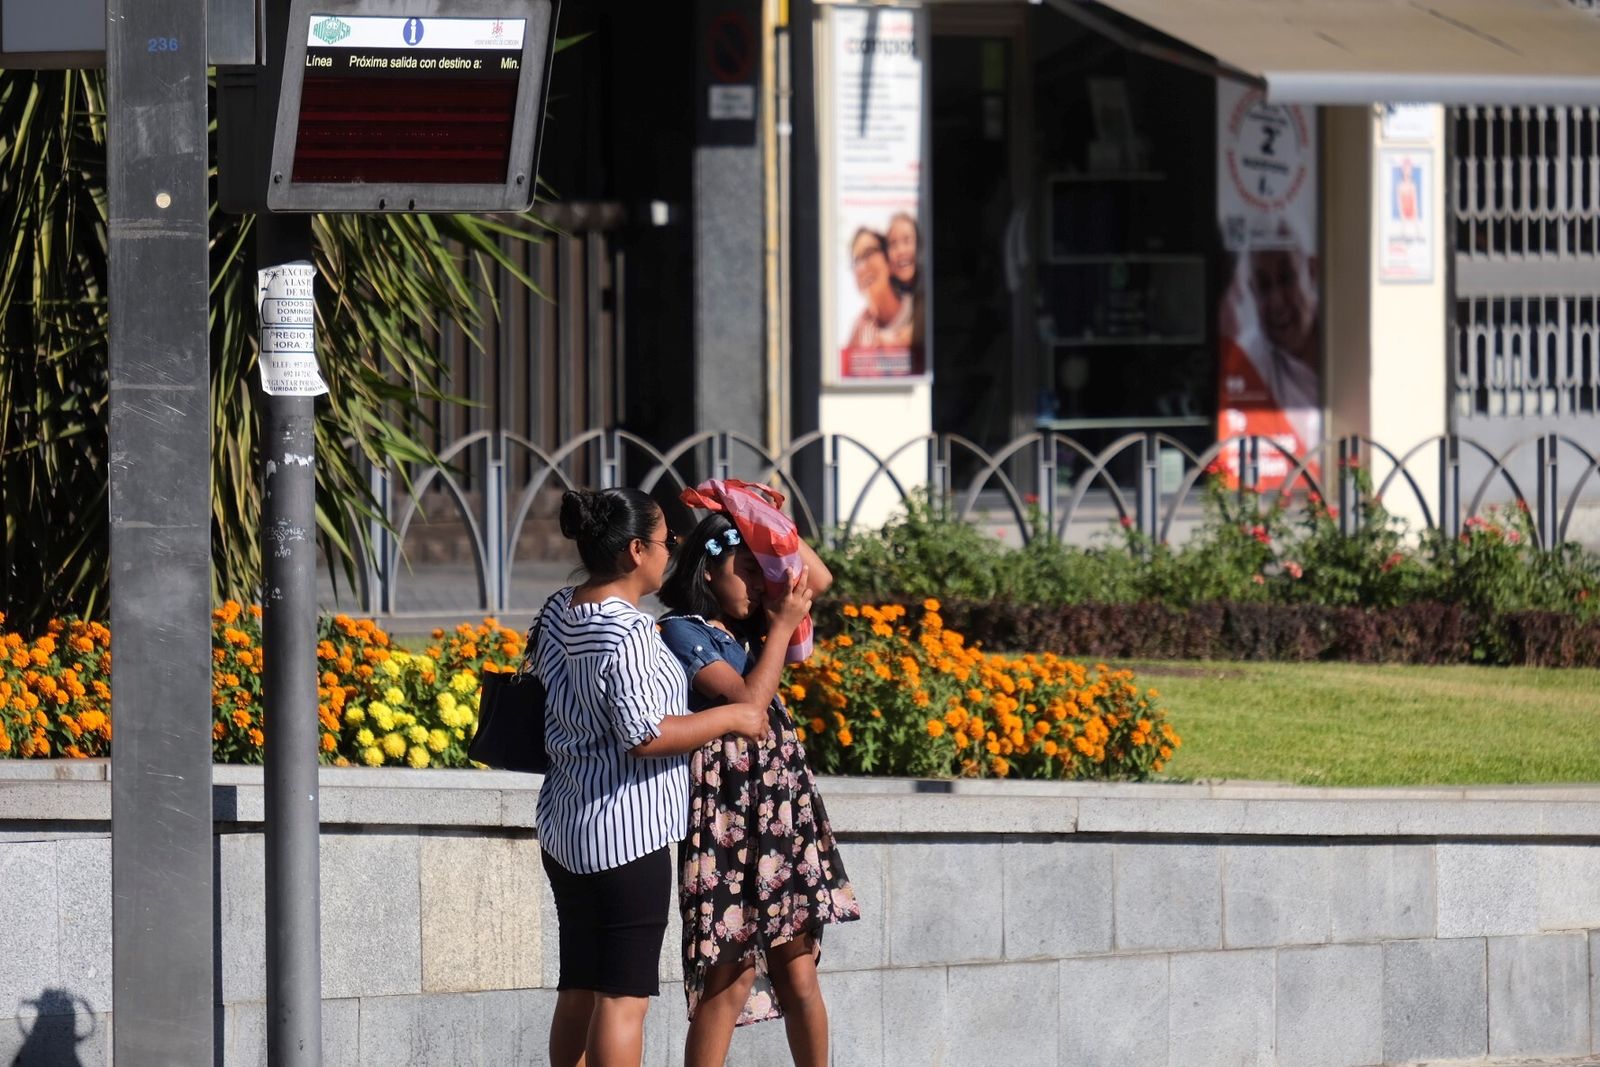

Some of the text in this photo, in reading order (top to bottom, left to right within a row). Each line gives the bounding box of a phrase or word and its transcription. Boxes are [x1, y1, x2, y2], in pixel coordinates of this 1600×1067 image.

[305, 54, 520, 69] Línea Próxima salida con destino a: Min.
[276, 300, 304, 308] TODOS
